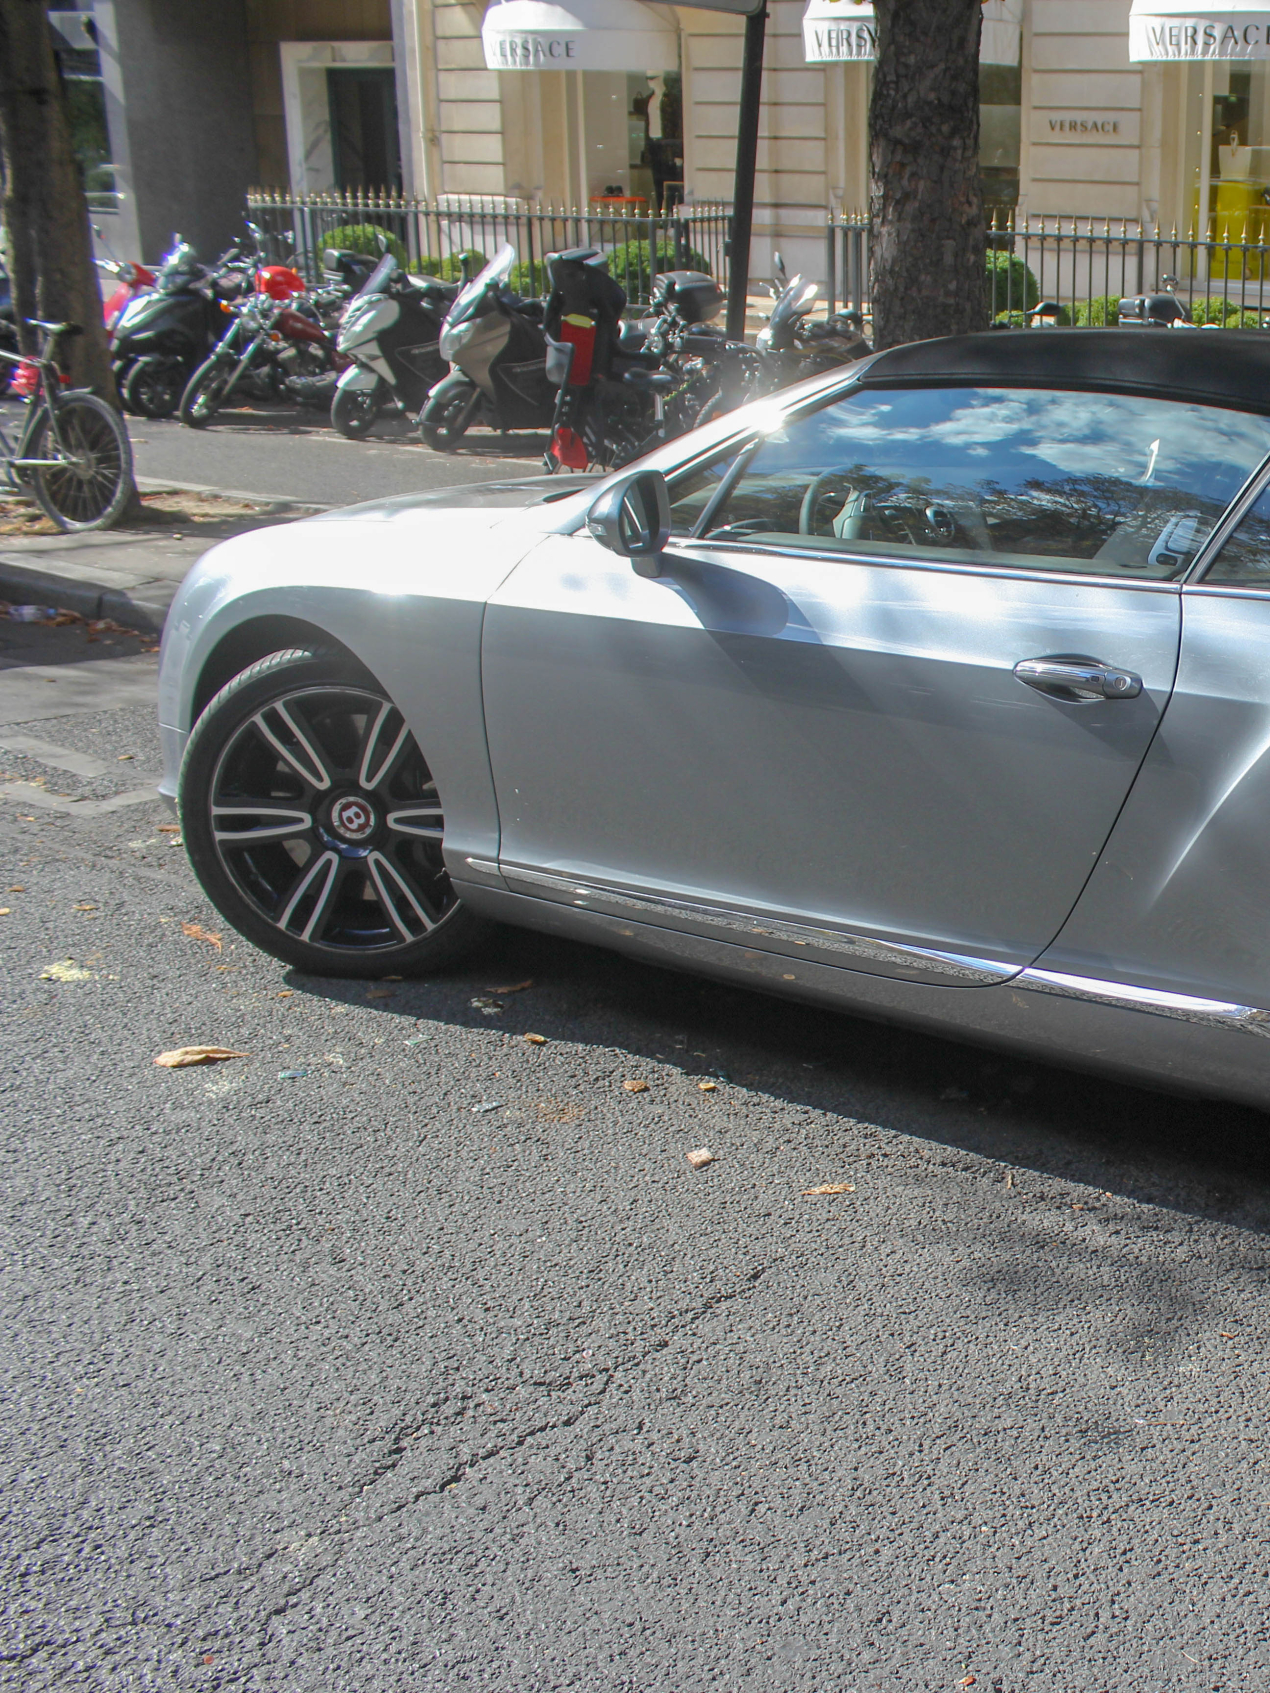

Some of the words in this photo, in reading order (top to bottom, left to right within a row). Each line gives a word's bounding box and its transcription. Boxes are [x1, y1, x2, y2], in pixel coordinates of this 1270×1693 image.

[814, 27, 868, 48] VERS
[490, 40, 576, 58] VERSACE
[1048, 119, 1120, 134] VERSACE
